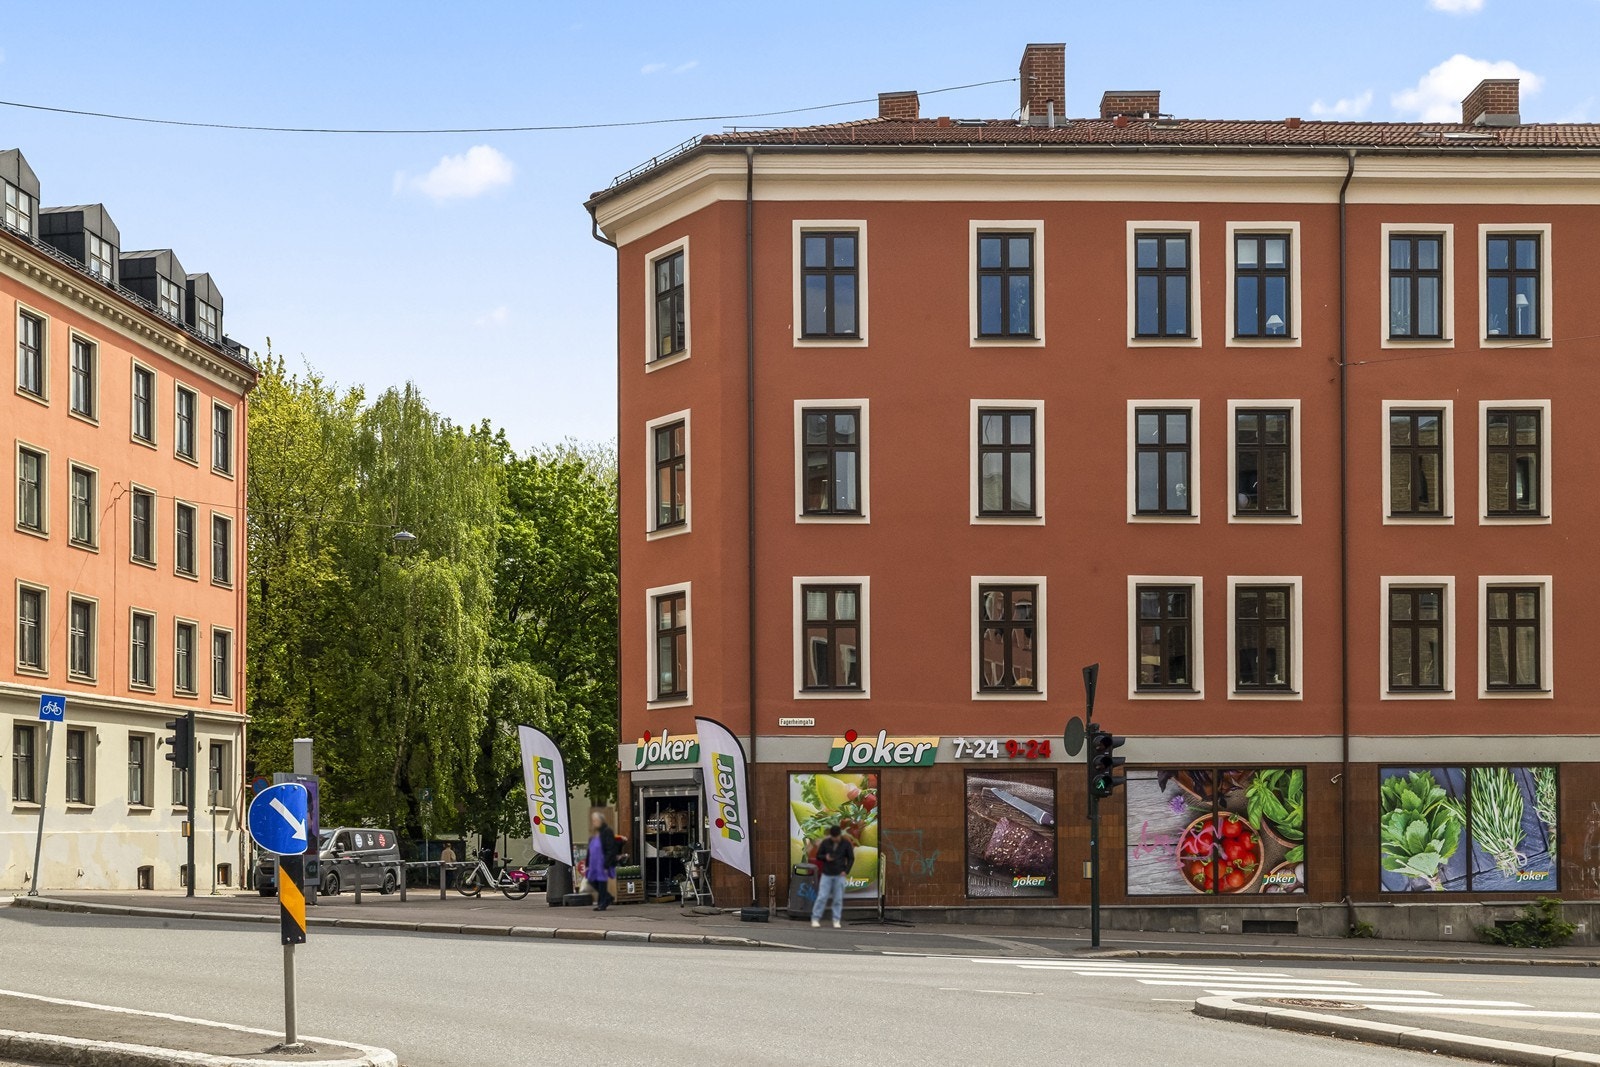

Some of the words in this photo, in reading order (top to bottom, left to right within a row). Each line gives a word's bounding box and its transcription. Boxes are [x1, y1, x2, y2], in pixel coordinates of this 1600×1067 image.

[636, 728, 695, 770] joker
[832, 729, 933, 772] joker
[953, 737, 999, 759] 7-24
[1005, 739, 1051, 759] 9-24
[530, 759, 564, 835] joker
[712, 758, 745, 840] joker
[843, 876, 867, 888] oker
[1013, 874, 1044, 888] joker
[1263, 872, 1293, 886] joker
[1516, 869, 1547, 883] joker
